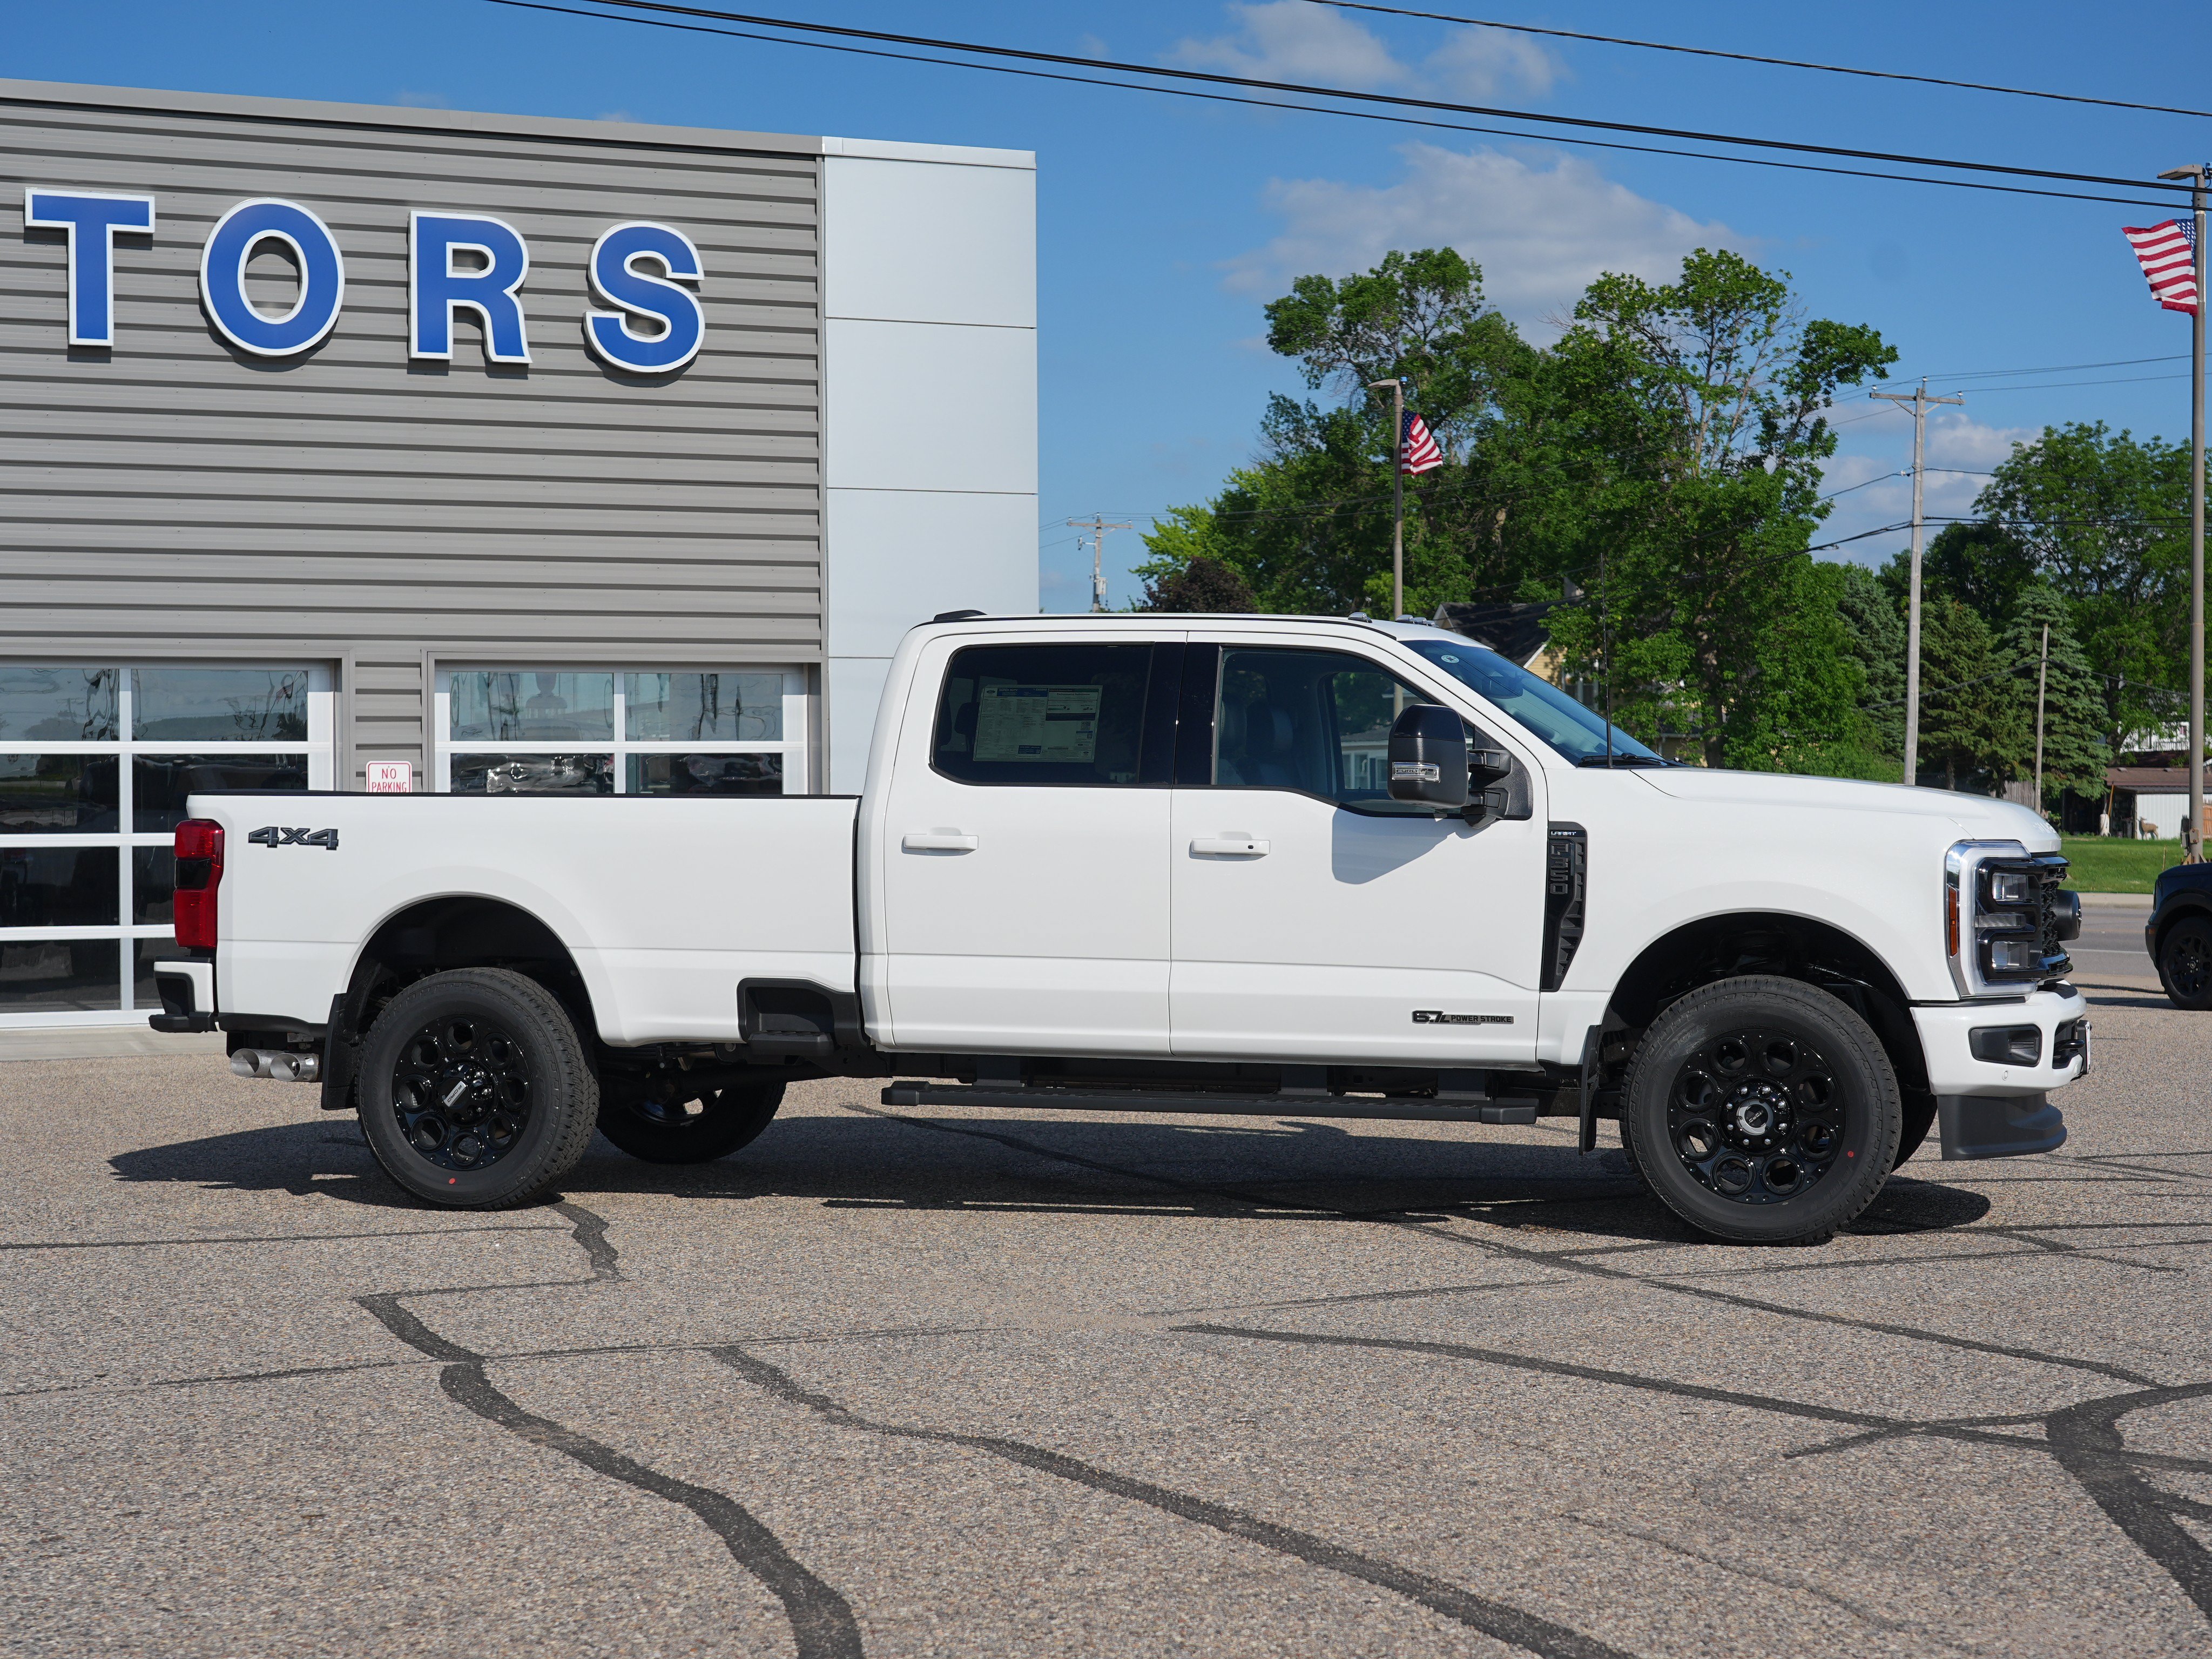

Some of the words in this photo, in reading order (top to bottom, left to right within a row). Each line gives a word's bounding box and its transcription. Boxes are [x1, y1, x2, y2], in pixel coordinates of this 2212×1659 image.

[24, 186, 705, 373] TORS
[382, 768, 396, 779] NO
[372, 781, 407, 793] PARKING
[1412, 1010, 1450, 1023] 6.7L
[447, 1084, 462, 1103] FORD
